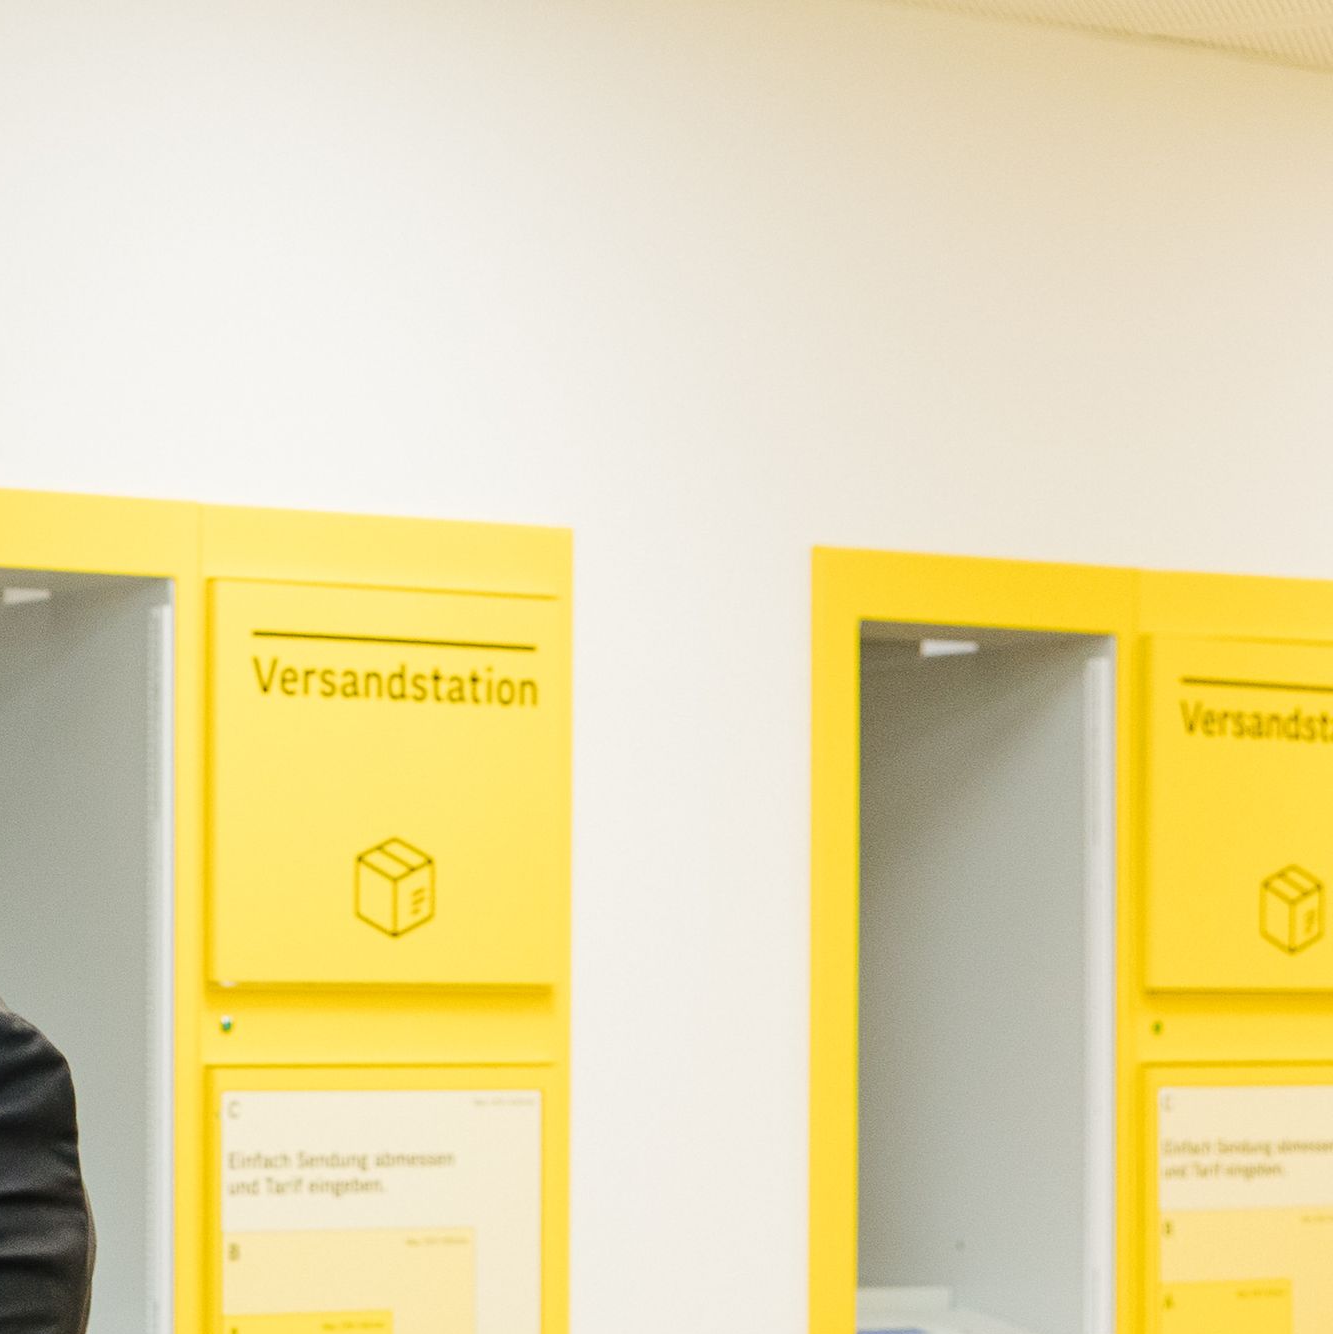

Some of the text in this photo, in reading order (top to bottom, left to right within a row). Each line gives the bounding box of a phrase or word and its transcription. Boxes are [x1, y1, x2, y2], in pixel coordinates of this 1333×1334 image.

[251, 655, 540, 707] Versandstation
[228, 1151, 456, 1173] Einfach Sendung abmessen
[228, 1177, 385, 1199] und Tarif eingeben.
